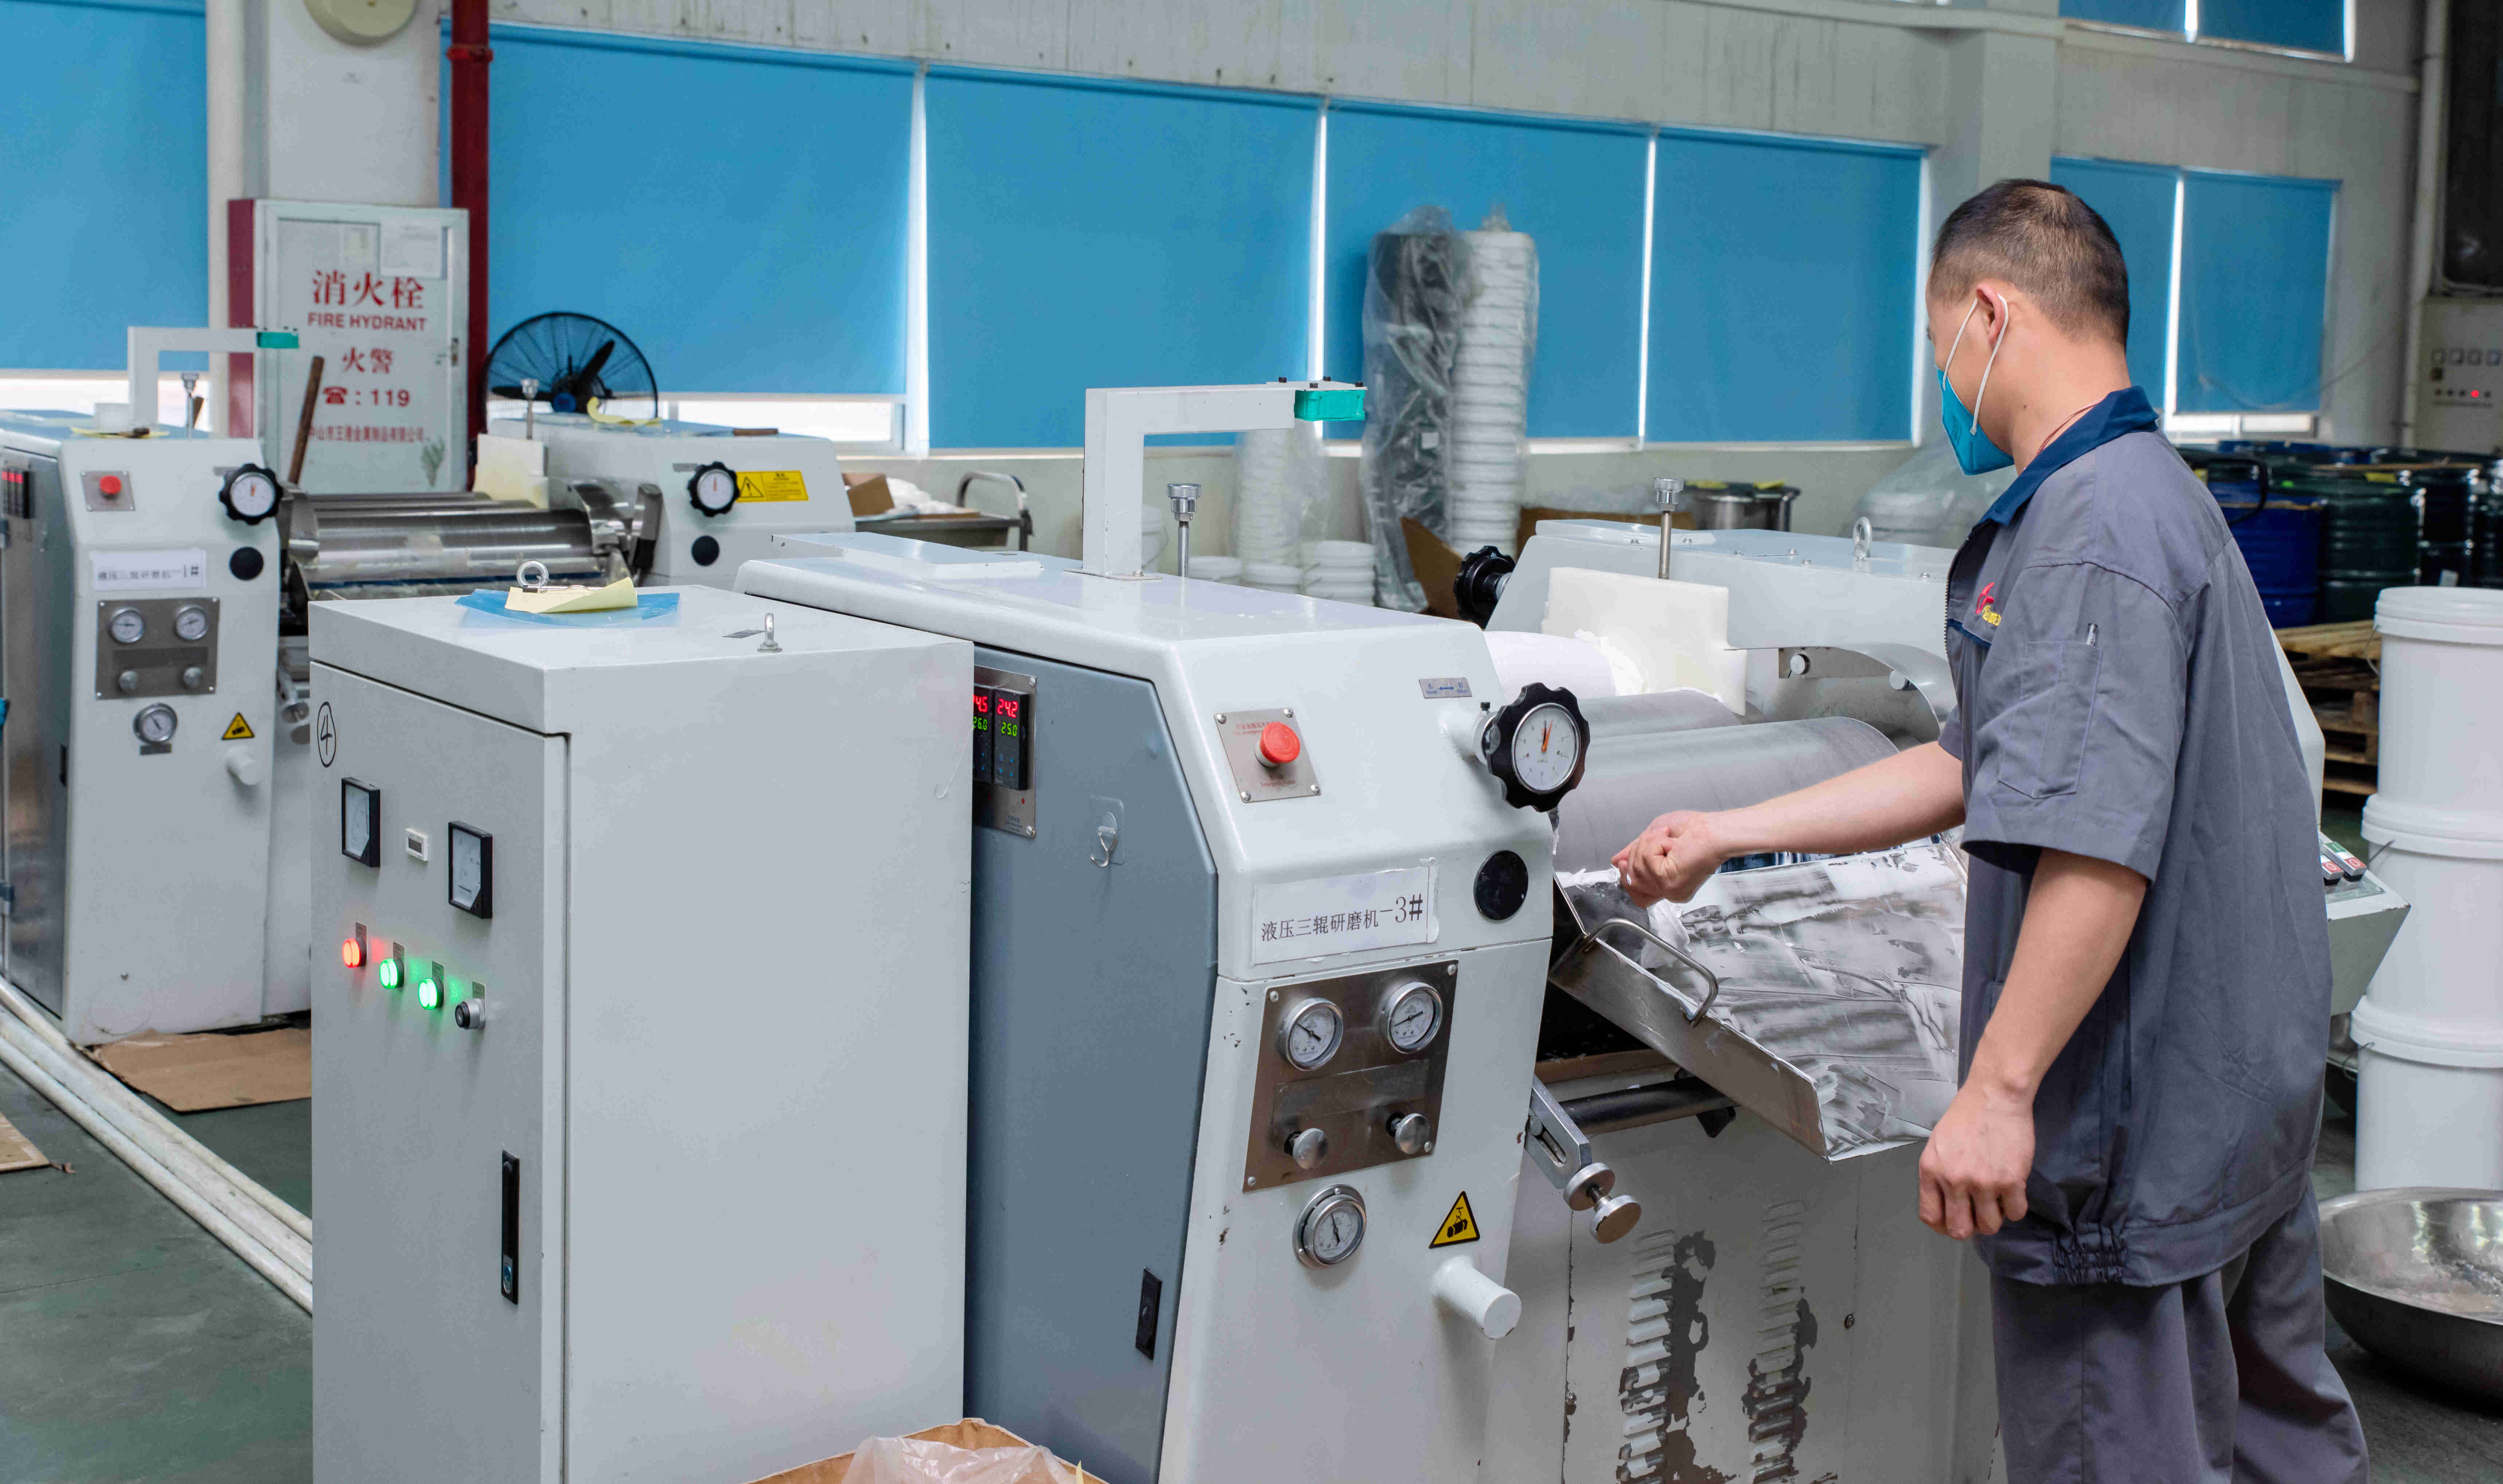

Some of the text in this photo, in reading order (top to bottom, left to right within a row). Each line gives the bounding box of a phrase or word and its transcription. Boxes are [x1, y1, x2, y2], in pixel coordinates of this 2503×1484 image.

[312, 270, 424, 309] 消火栓
[308, 312, 427, 331] FIRE HYDRANT
[342, 346, 394, 374] 火警
